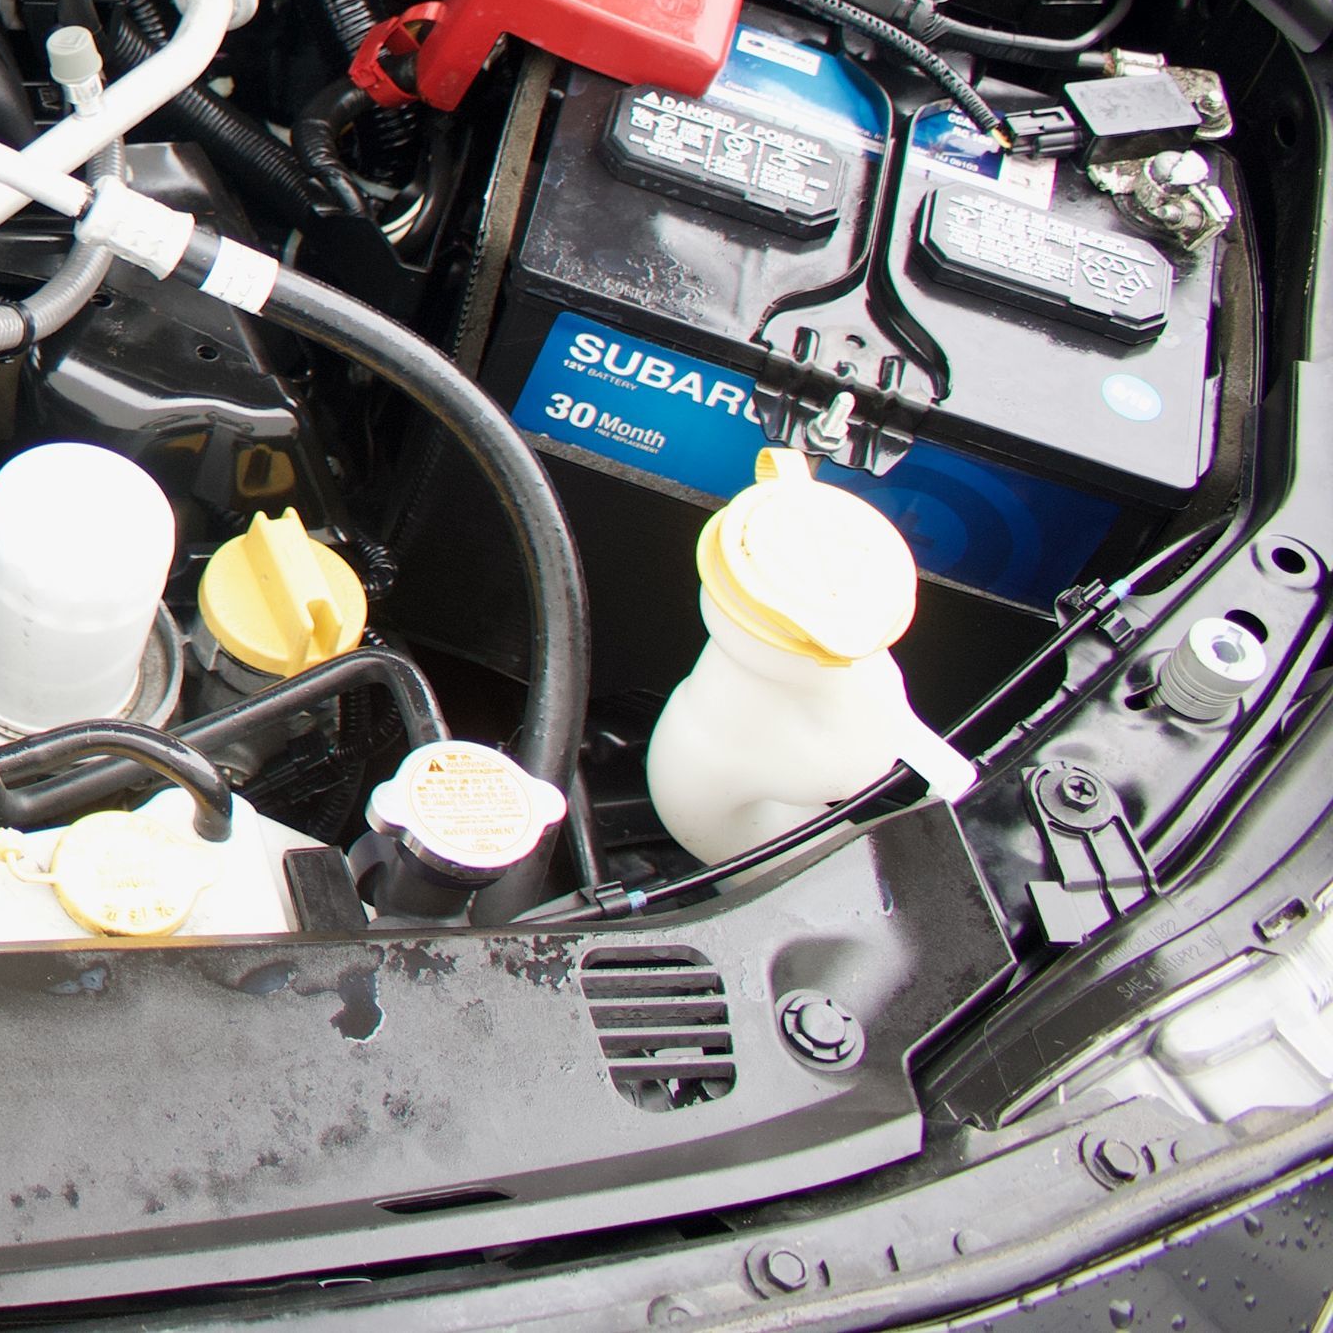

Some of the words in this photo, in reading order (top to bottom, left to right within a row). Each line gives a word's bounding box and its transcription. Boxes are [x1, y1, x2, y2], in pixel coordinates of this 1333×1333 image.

[660, 95, 739, 130] DANGER
[753, 125, 823, 156] POISON
[562, 358, 586, 373] 12V
[586, 367, 639, 392] BATTERY
[544, 392, 598, 429] 30
[598, 411, 667, 449] Month
[593, 426, 612, 441] FREE
[611, 433, 660, 455] REPLACEMENT
